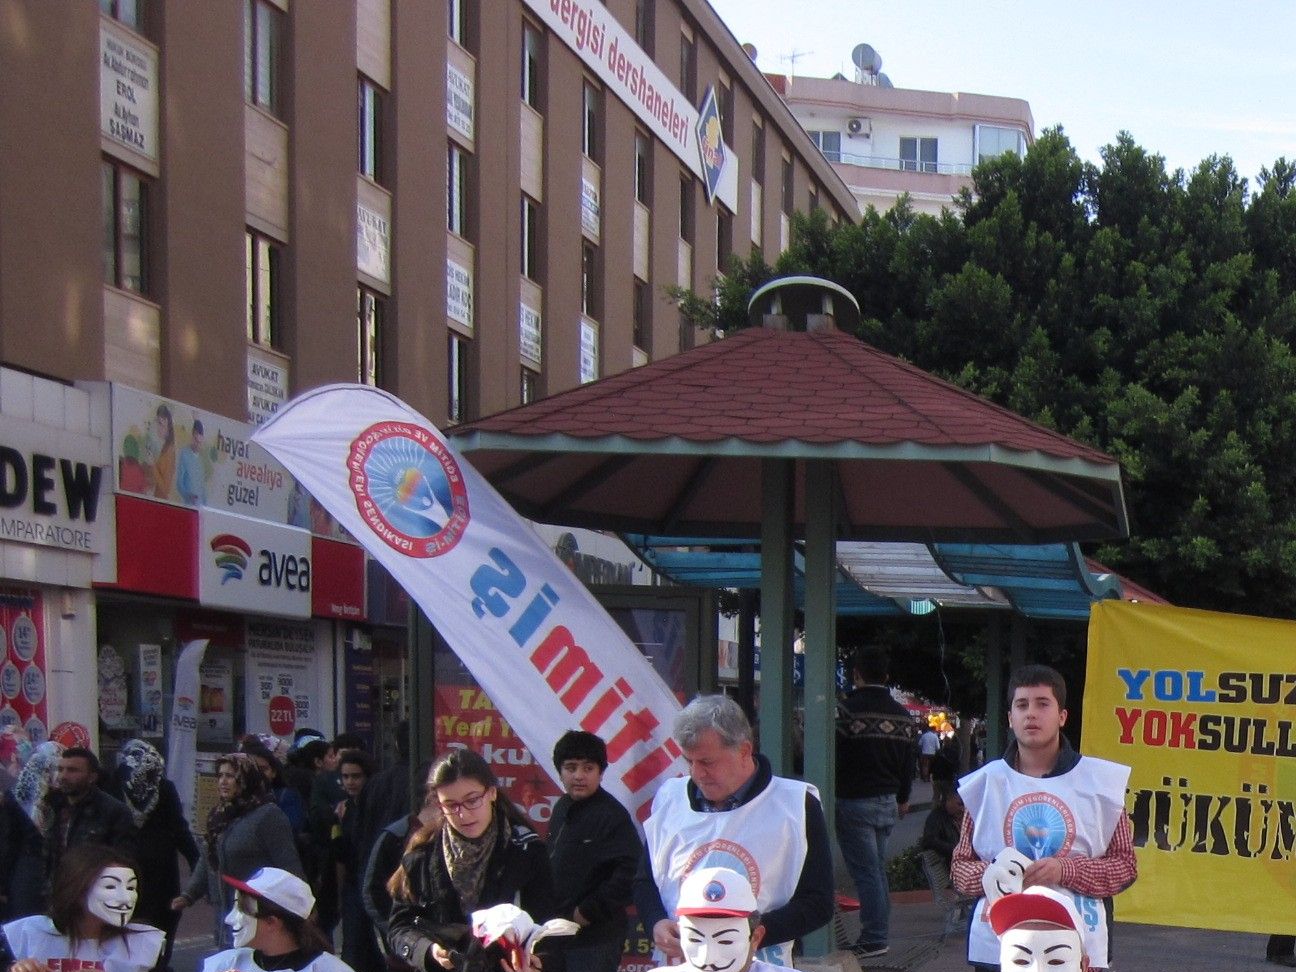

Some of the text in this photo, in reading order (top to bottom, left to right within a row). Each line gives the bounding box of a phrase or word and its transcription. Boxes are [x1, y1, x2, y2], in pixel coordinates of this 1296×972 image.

[608, 37, 689, 149] dershaneleri
[252, 362, 280, 381] AVUKAT
[227, 482, 260, 508] güzel
[258, 549, 311, 593] avea
